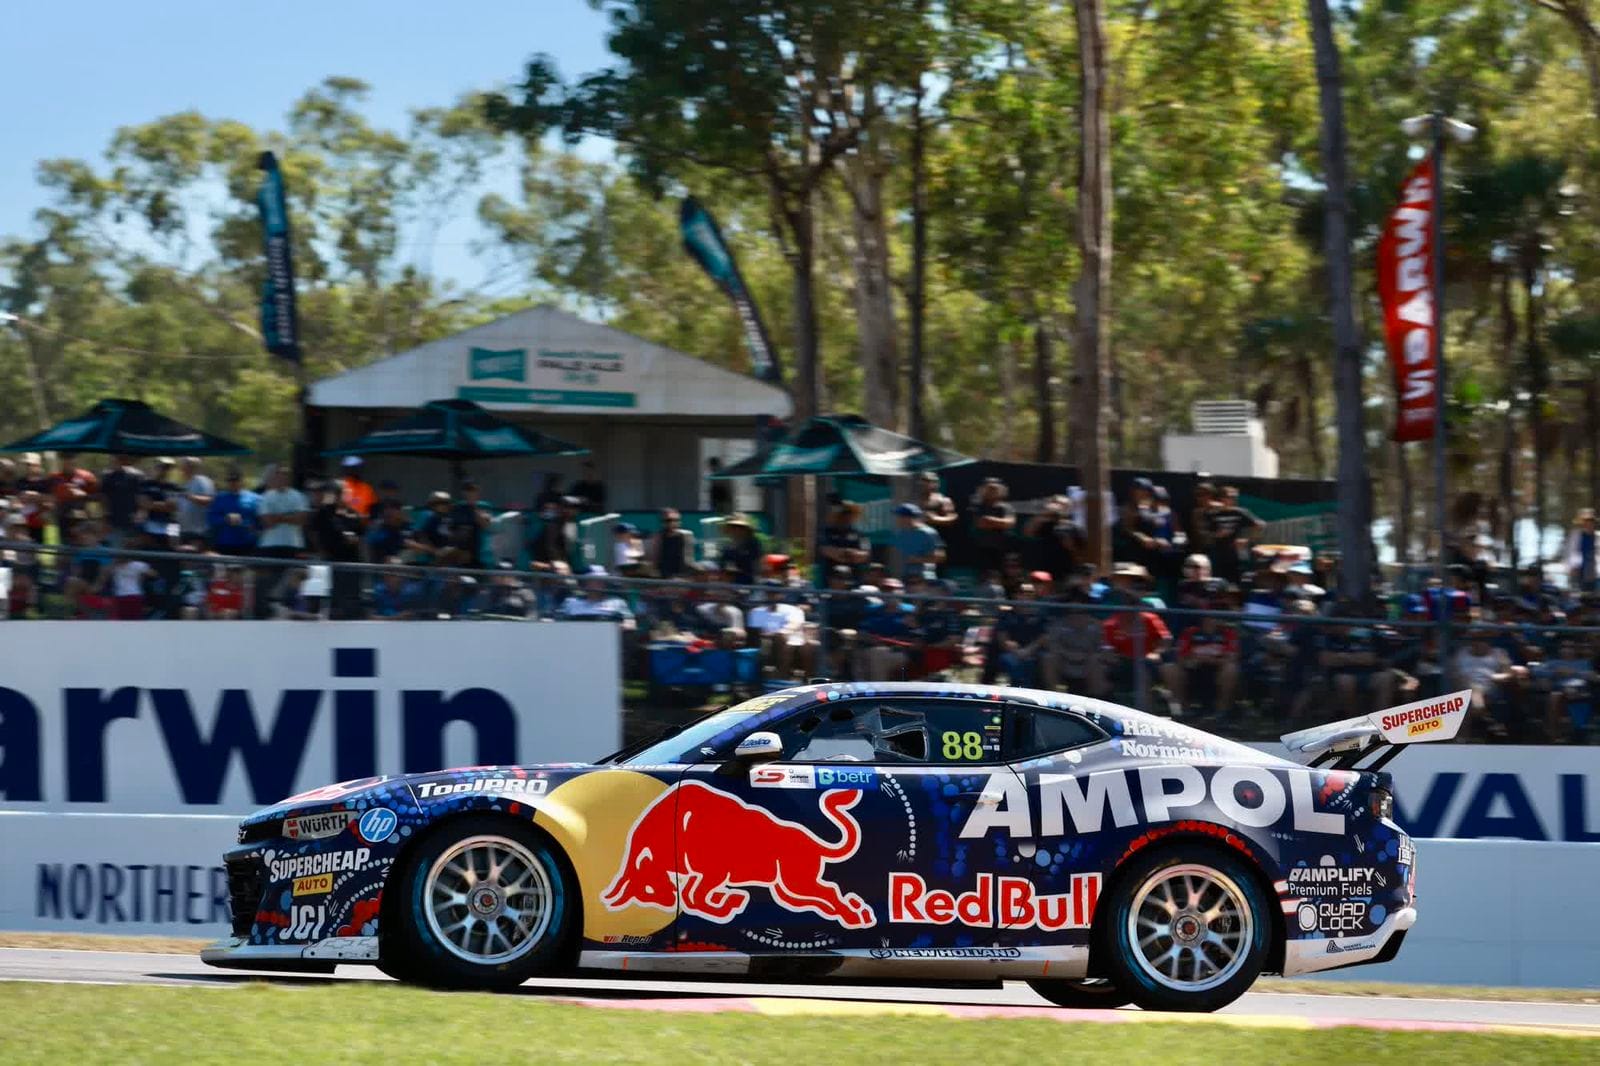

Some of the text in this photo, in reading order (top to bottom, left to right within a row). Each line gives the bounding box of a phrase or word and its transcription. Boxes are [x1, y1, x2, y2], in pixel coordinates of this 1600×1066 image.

[1382, 697, 1464, 731] SUPERCHEAP
[1120, 718, 1193, 743] Harvey
[1411, 720, 1439, 734] AUTO
[942, 731, 984, 760] 88
[1120, 740, 1206, 760] Norman
[838, 770, 872, 784] betr
[959, 764, 1345, 838] AMPOL
[364, 808, 393, 840] hp
[269, 848, 371, 883] SUPERCHEAP
[1300, 868, 1374, 881] AMPLIFY
[297, 878, 328, 892] AUTO
[1289, 882, 1373, 896] Premium Fuels
[889, 872, 1102, 931] Red Bull
[1319, 903, 1365, 917] QUAD
[1319, 917, 1364, 930] LOCK
[622, 934, 653, 946] Repco
[895, 948, 1021, 958] NEW HOLLAND
